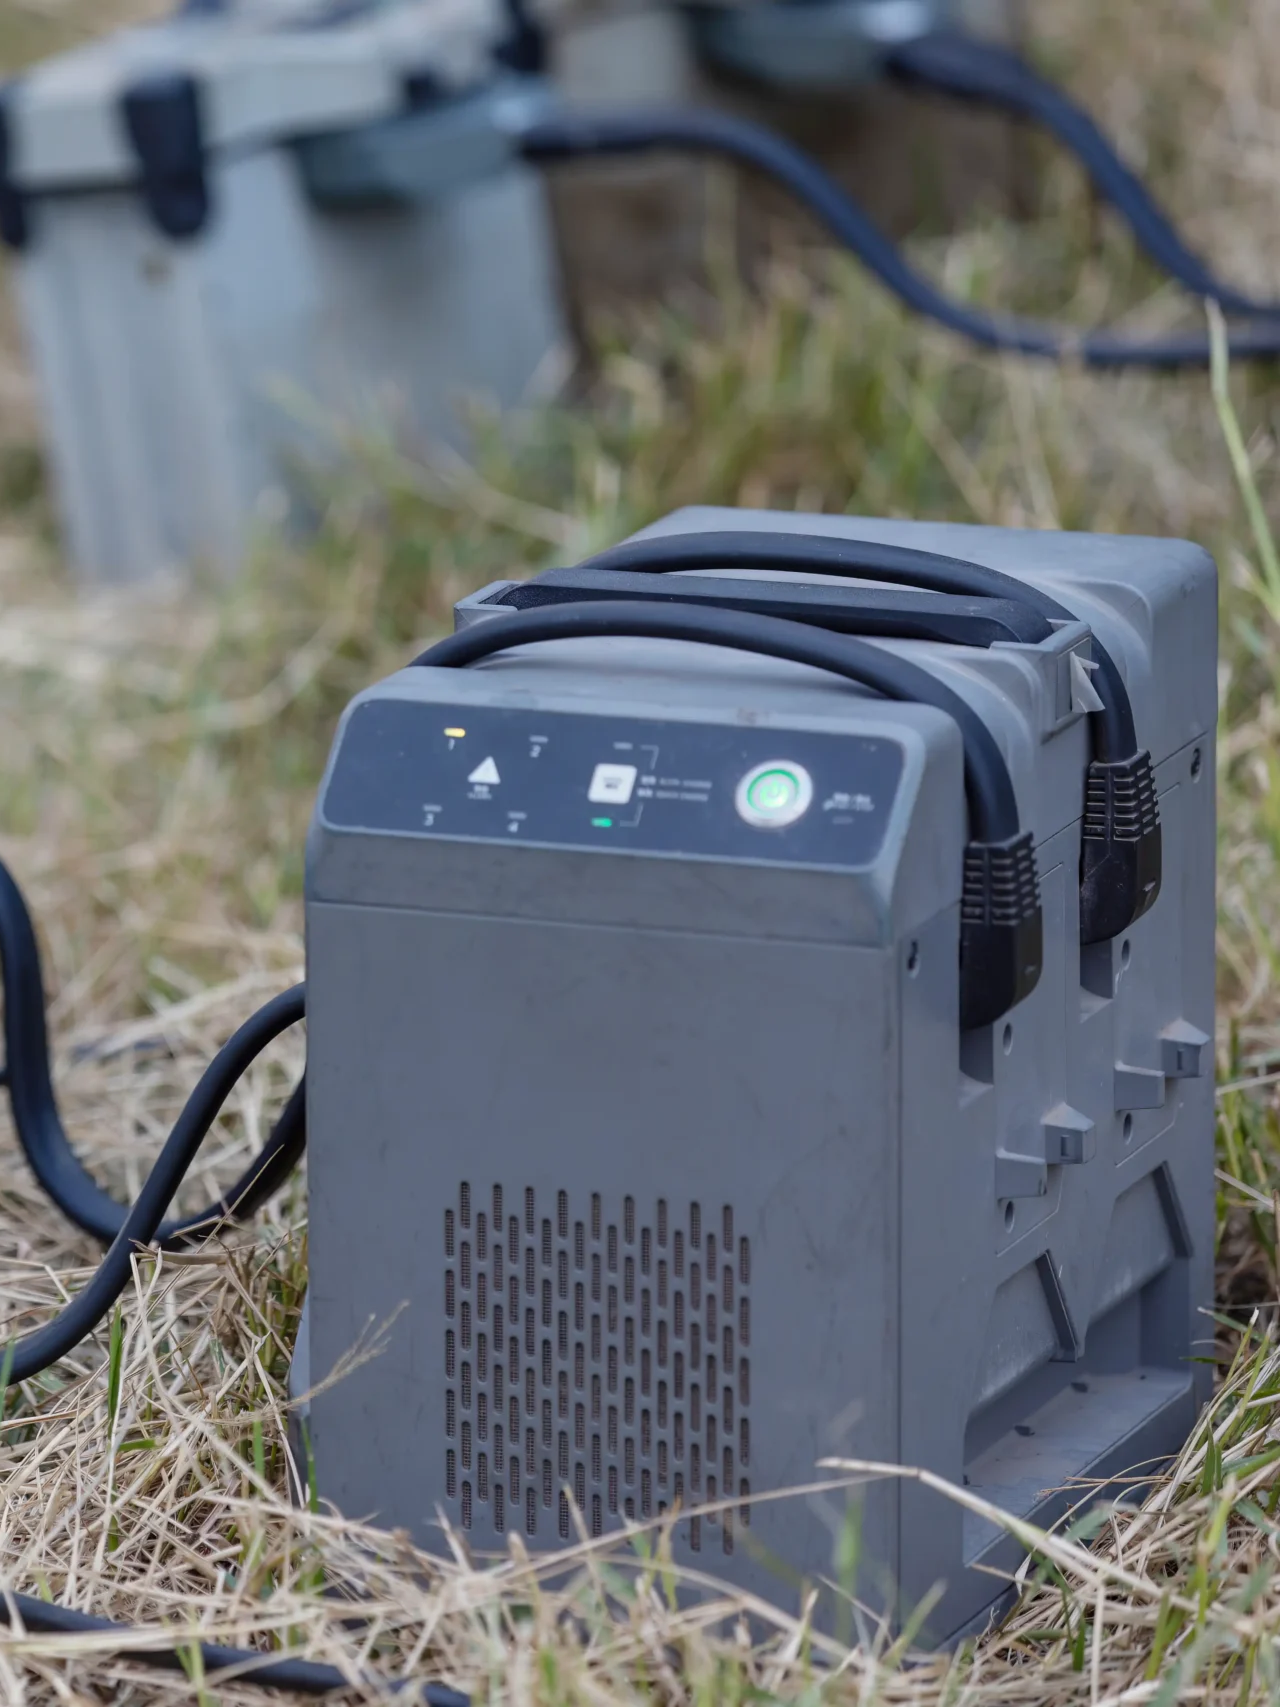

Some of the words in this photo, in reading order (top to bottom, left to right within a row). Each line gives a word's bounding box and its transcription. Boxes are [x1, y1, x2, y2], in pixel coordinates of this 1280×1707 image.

[448, 738, 455, 751] 1
[530, 744, 541, 758] 2
[424, 812, 434, 826] 3
[507, 820, 518, 833] 4
